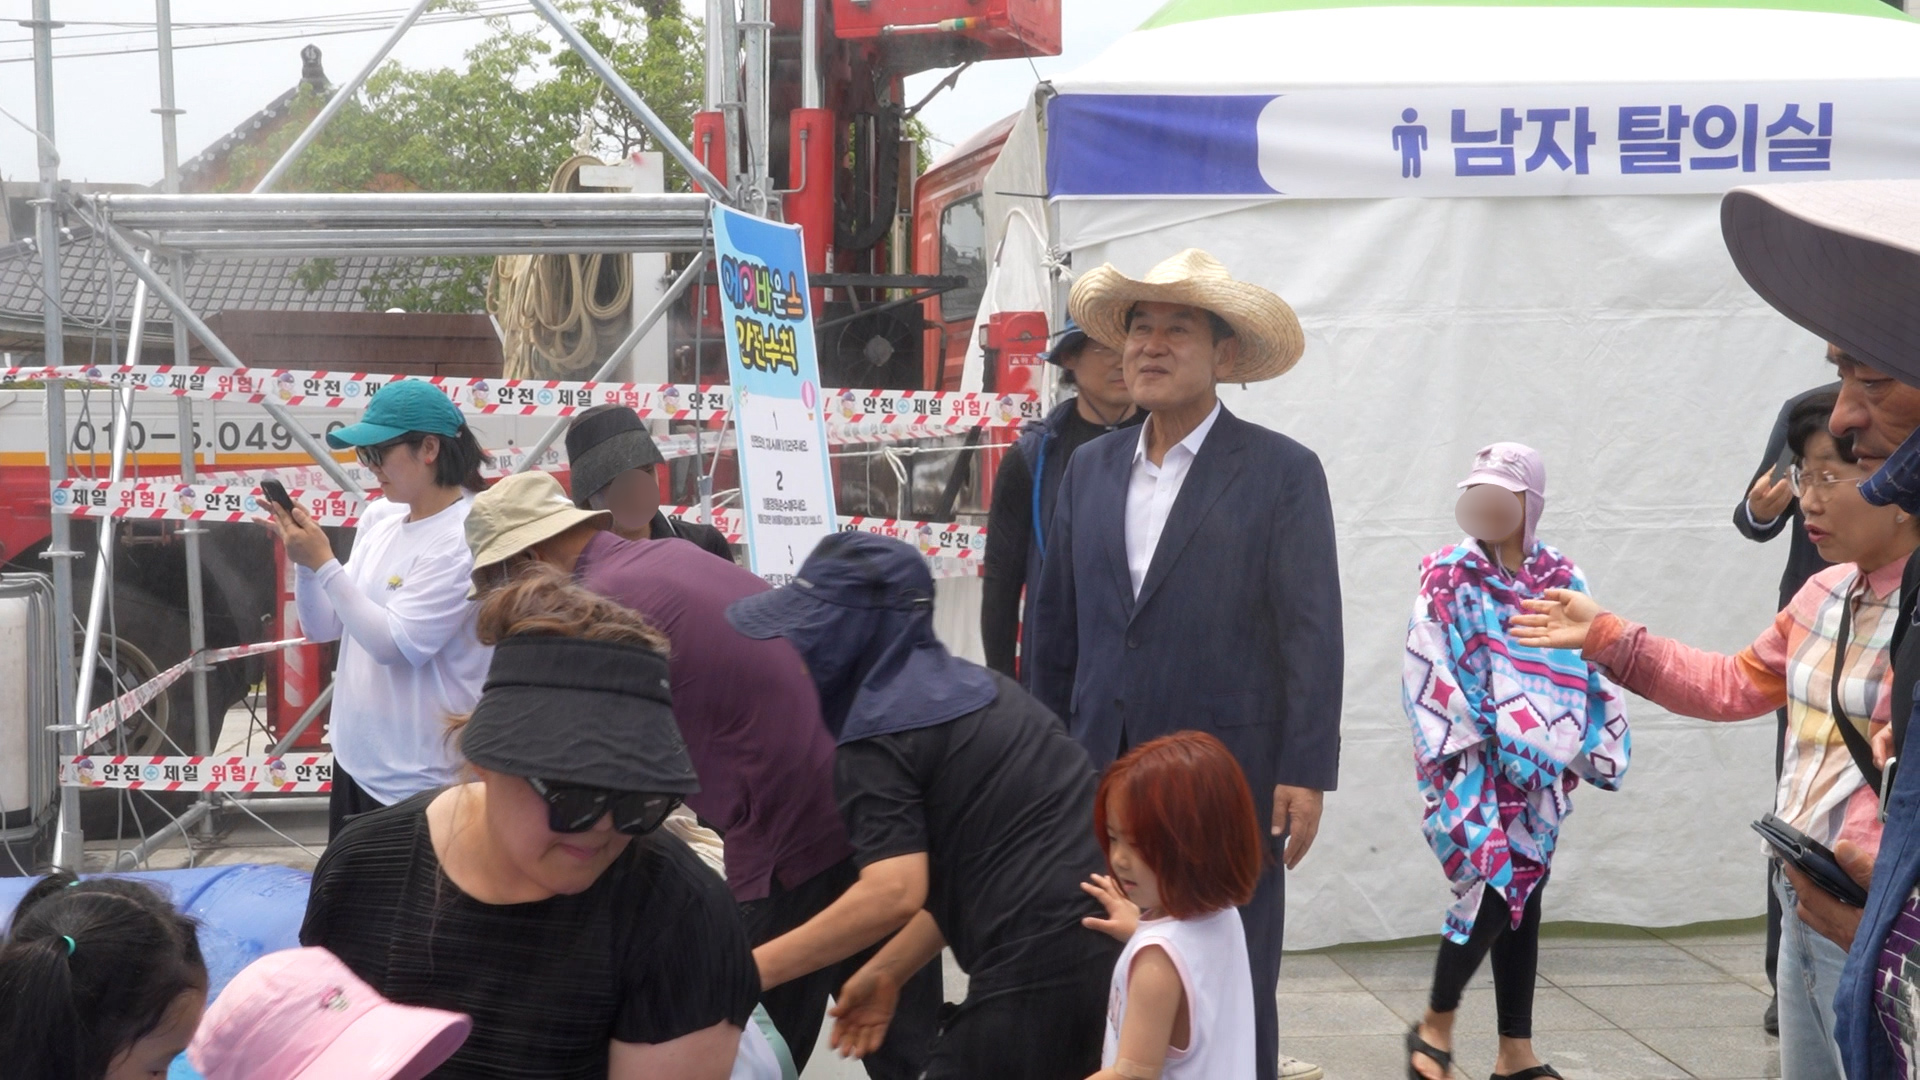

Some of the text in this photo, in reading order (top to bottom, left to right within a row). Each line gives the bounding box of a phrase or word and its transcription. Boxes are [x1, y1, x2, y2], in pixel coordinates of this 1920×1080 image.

[1450, 102, 1834, 177] 남자 탈의실
[735, 315, 799, 376] 안전수칙
[169, 373, 204, 391] 제일
[218, 375, 264, 394] 위험!
[303, 378, 341, 397] 안전
[497, 386, 724, 410] 안전 제일 위험! 안전
[863, 397, 894, 415] 안전
[913, 399, 942, 416] 제일
[952, 400, 990, 416] 위험!
[776, 470, 784, 491] 2
[72, 487, 358, 517] 제일 위험! 안전 위험!
[939, 531, 969, 549] 안전
[103, 763, 331, 783] 안전 제일 위험! 안전
